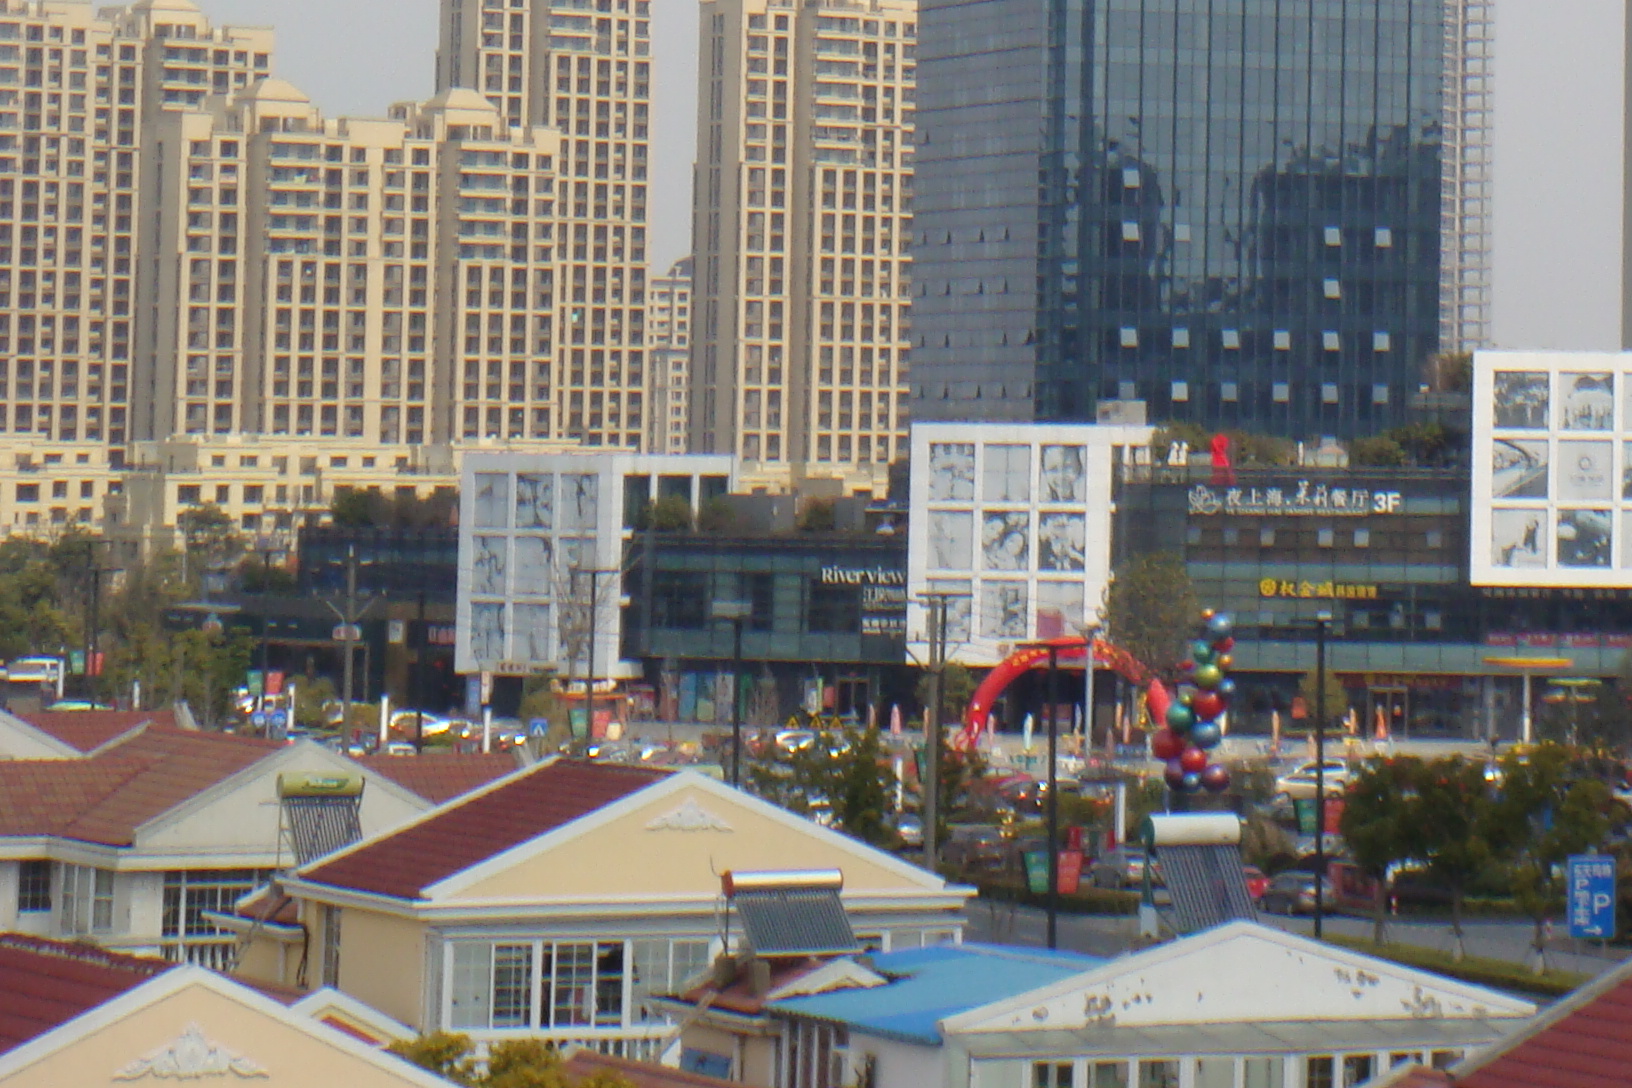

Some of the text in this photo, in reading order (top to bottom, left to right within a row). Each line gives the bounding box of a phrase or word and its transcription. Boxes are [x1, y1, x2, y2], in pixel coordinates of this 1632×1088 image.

[1373, 491, 1402, 514] 3F
[821, 565, 864, 584] River
[1593, 892, 1611, 915] P
